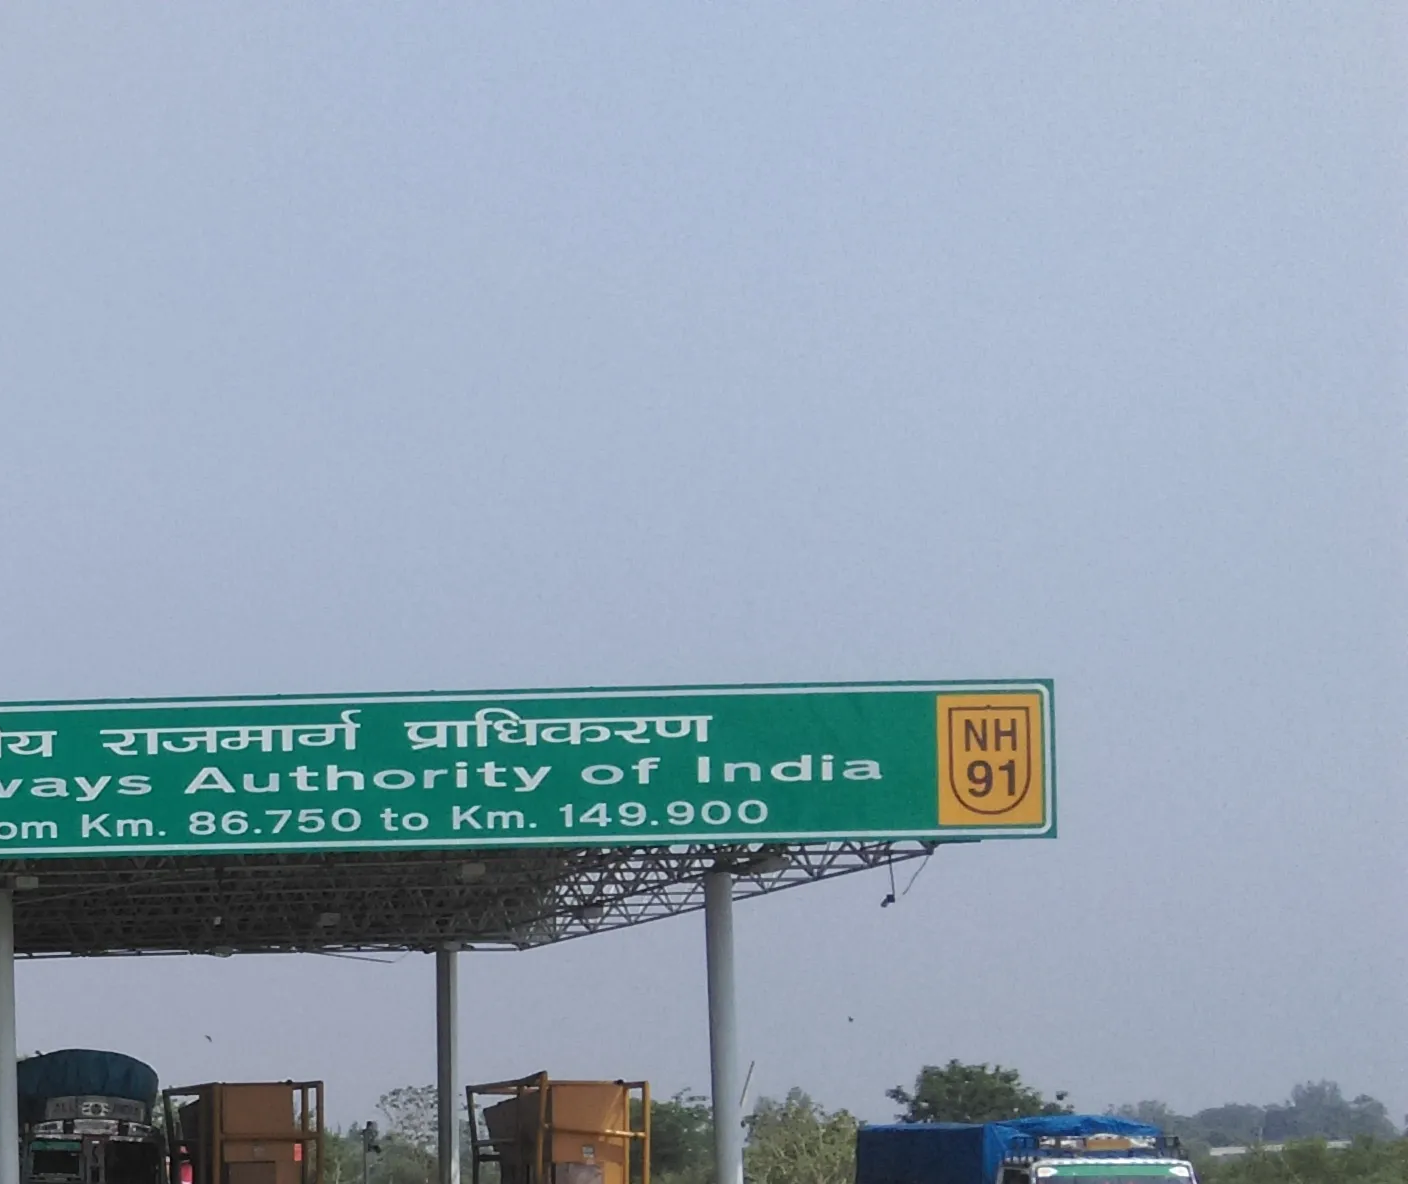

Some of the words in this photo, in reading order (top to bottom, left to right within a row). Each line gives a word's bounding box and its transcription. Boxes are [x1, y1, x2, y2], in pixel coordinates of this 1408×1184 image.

[100, 710, 362, 756] राजमार्ग
[404, 707, 714, 750] प्राधिकरण
[964, 718, 1018, 752] NH
[184, 761, 553, 795] Authority
[581, 756, 661, 785] of
[697, 754, 883, 783] India
[966, 759, 1016, 797] 91
[81, 813, 166, 838] Km.
[188, 808, 362, 835] 86.750
[379, 808, 429, 831] to
[451, 805, 538, 830] Km.
[559, 800, 769, 828] 149.900
